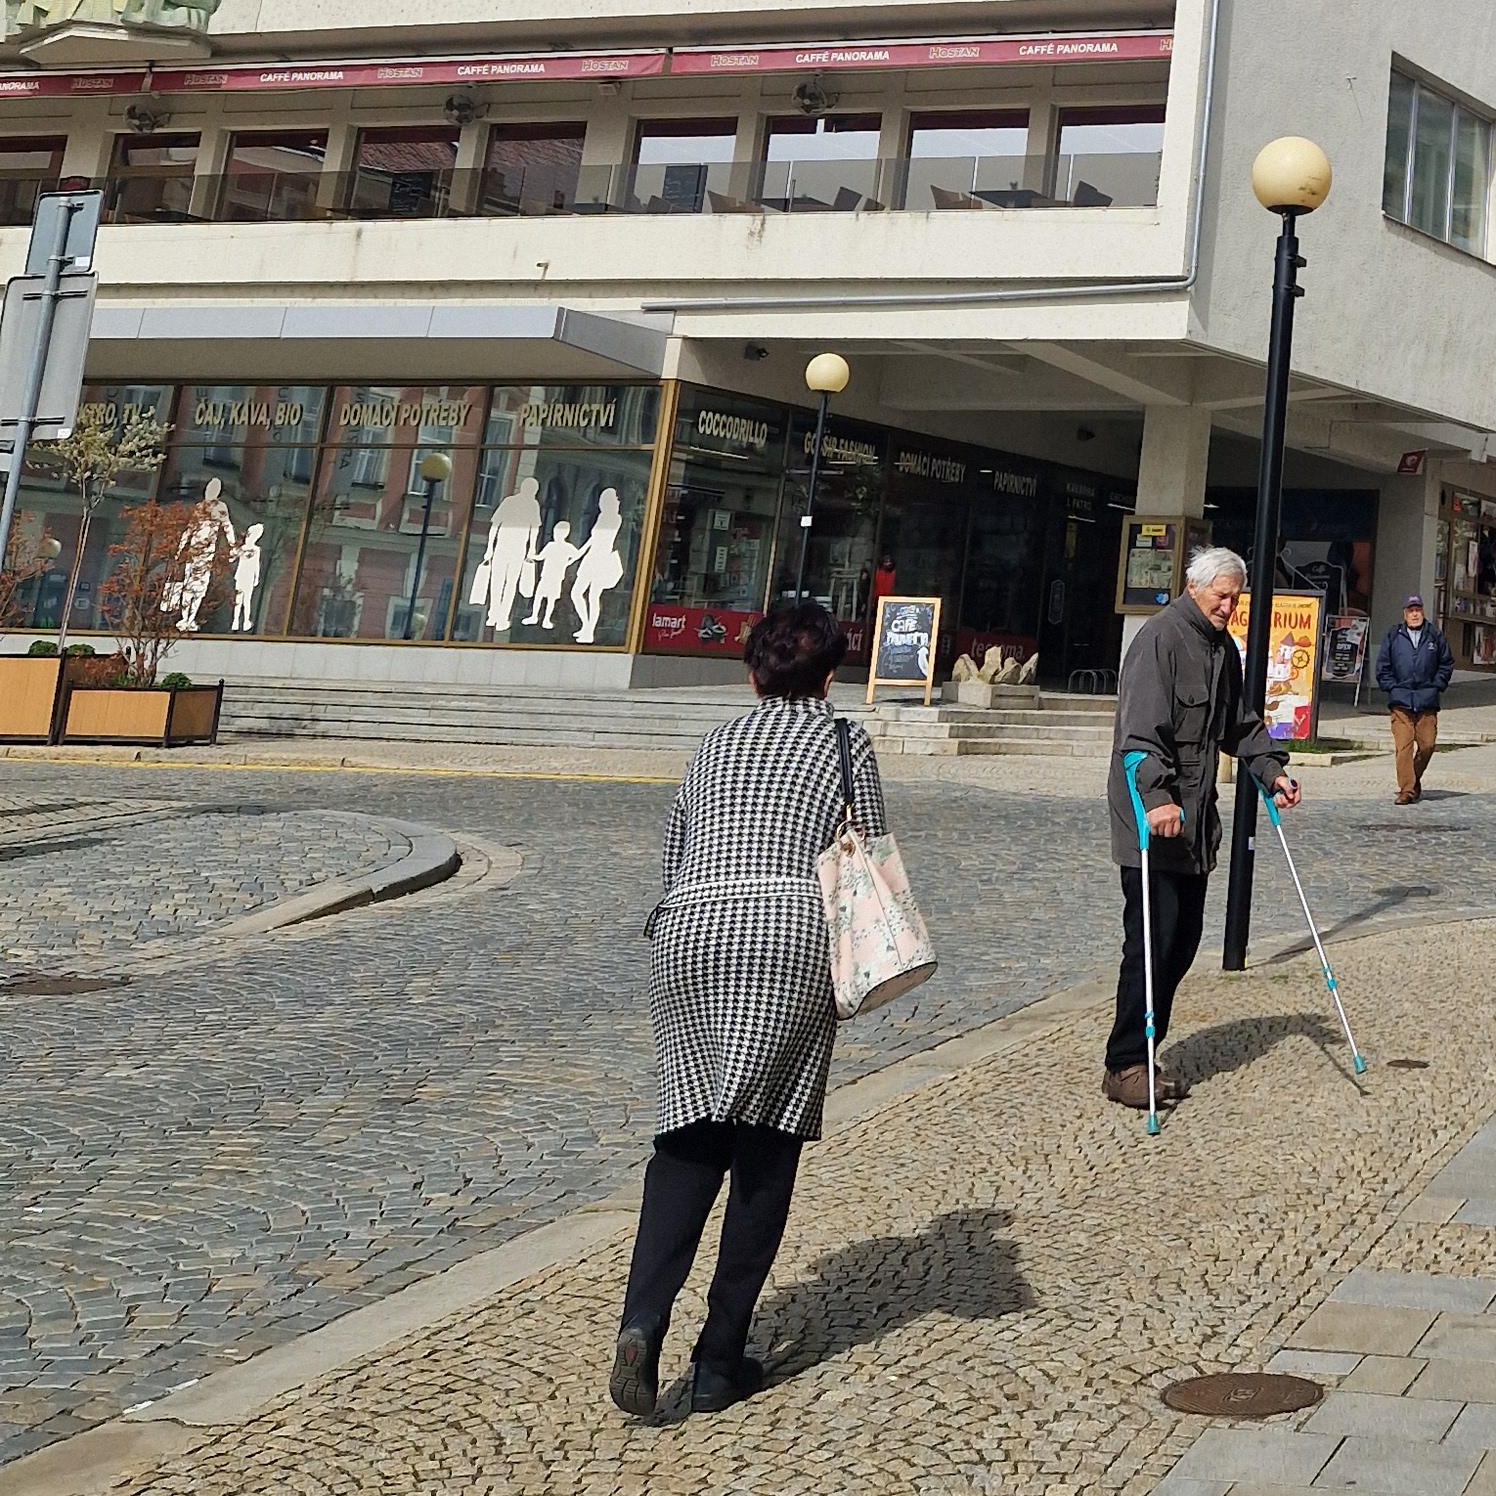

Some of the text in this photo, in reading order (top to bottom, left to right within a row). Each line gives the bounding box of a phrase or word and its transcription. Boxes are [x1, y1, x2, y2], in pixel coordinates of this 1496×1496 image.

[795, 50, 890, 63] CAFFÉ PANORAMA
[1019, 42, 1118, 55] CAFFÉ PANORAMA
[260, 70, 344, 83] CAFFÉ PANORAMA
[457, 63, 546, 76] CAFFÉ PANORAMA
[195, 396, 302, 431] ČAJ, KÁVA, BIO
[339, 397, 471, 427] DOMÁCÍ POTŘEBY
[519, 398, 617, 428] PAPÍRNICTVÍ
[698, 410, 768, 449] COCCODRILLO
[652, 612, 687, 629] lamart
